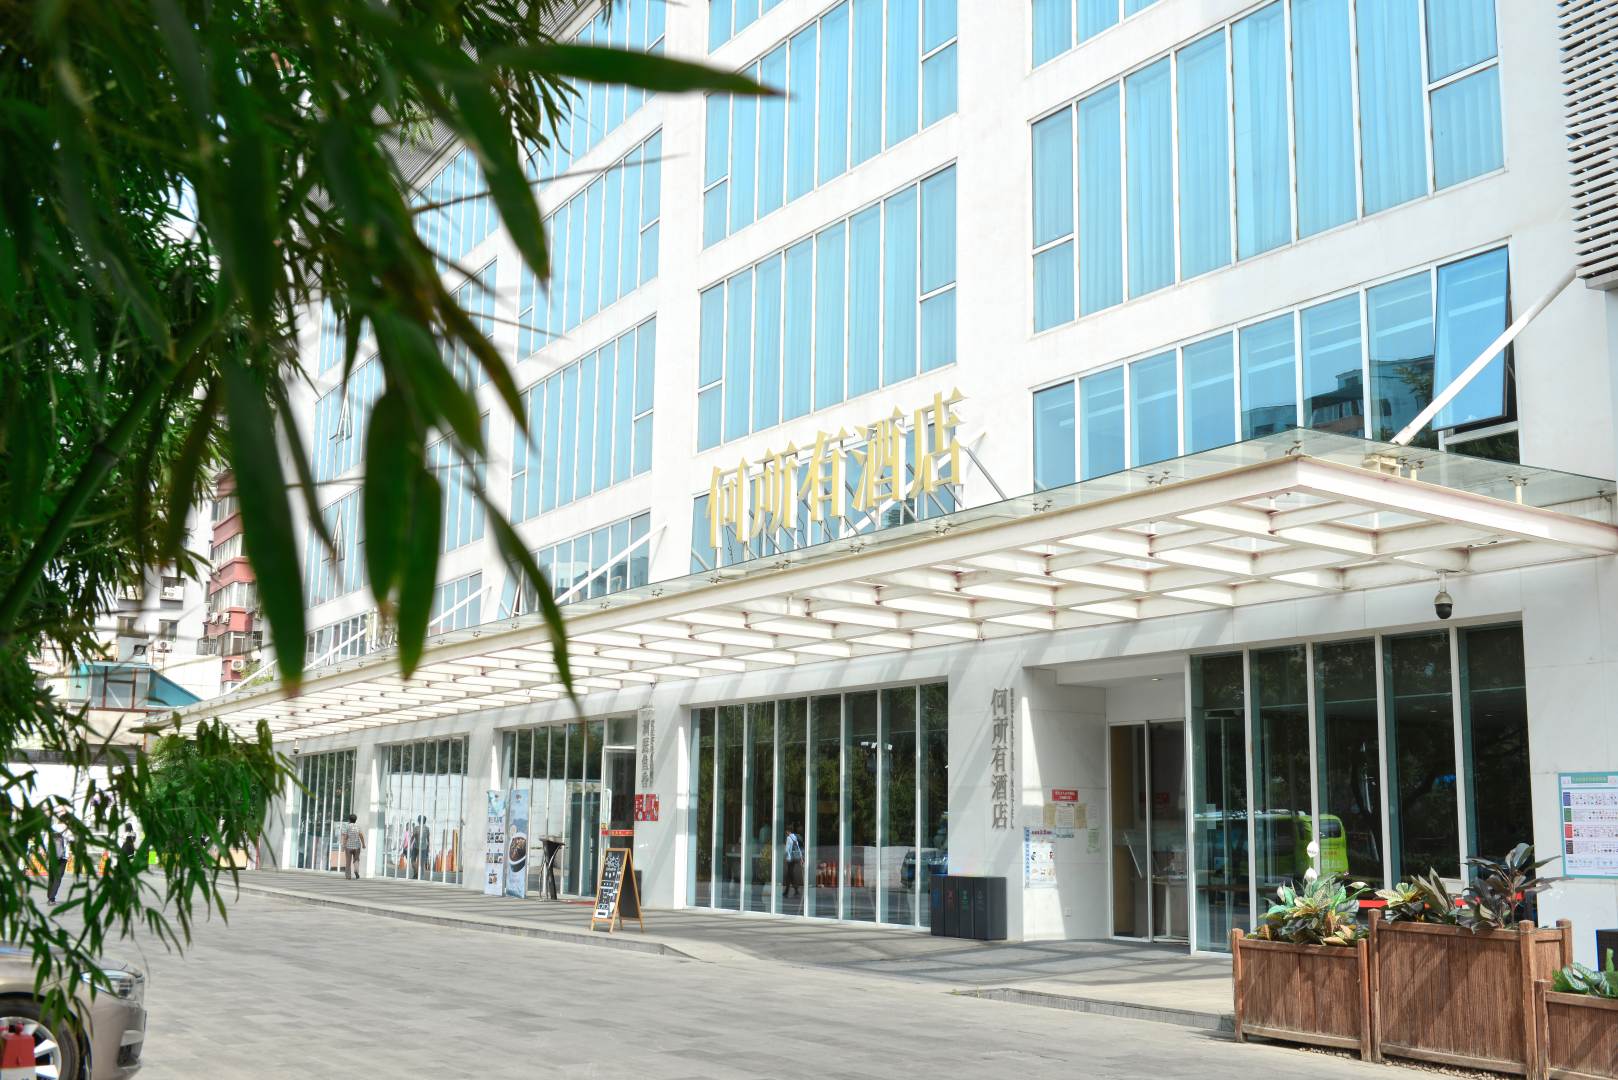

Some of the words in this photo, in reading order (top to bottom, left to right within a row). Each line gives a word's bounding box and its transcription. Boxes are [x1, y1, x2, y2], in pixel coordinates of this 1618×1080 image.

[705, 386, 968, 549] 何所有酒店
[990, 687, 1009, 830] 何所有酒店
